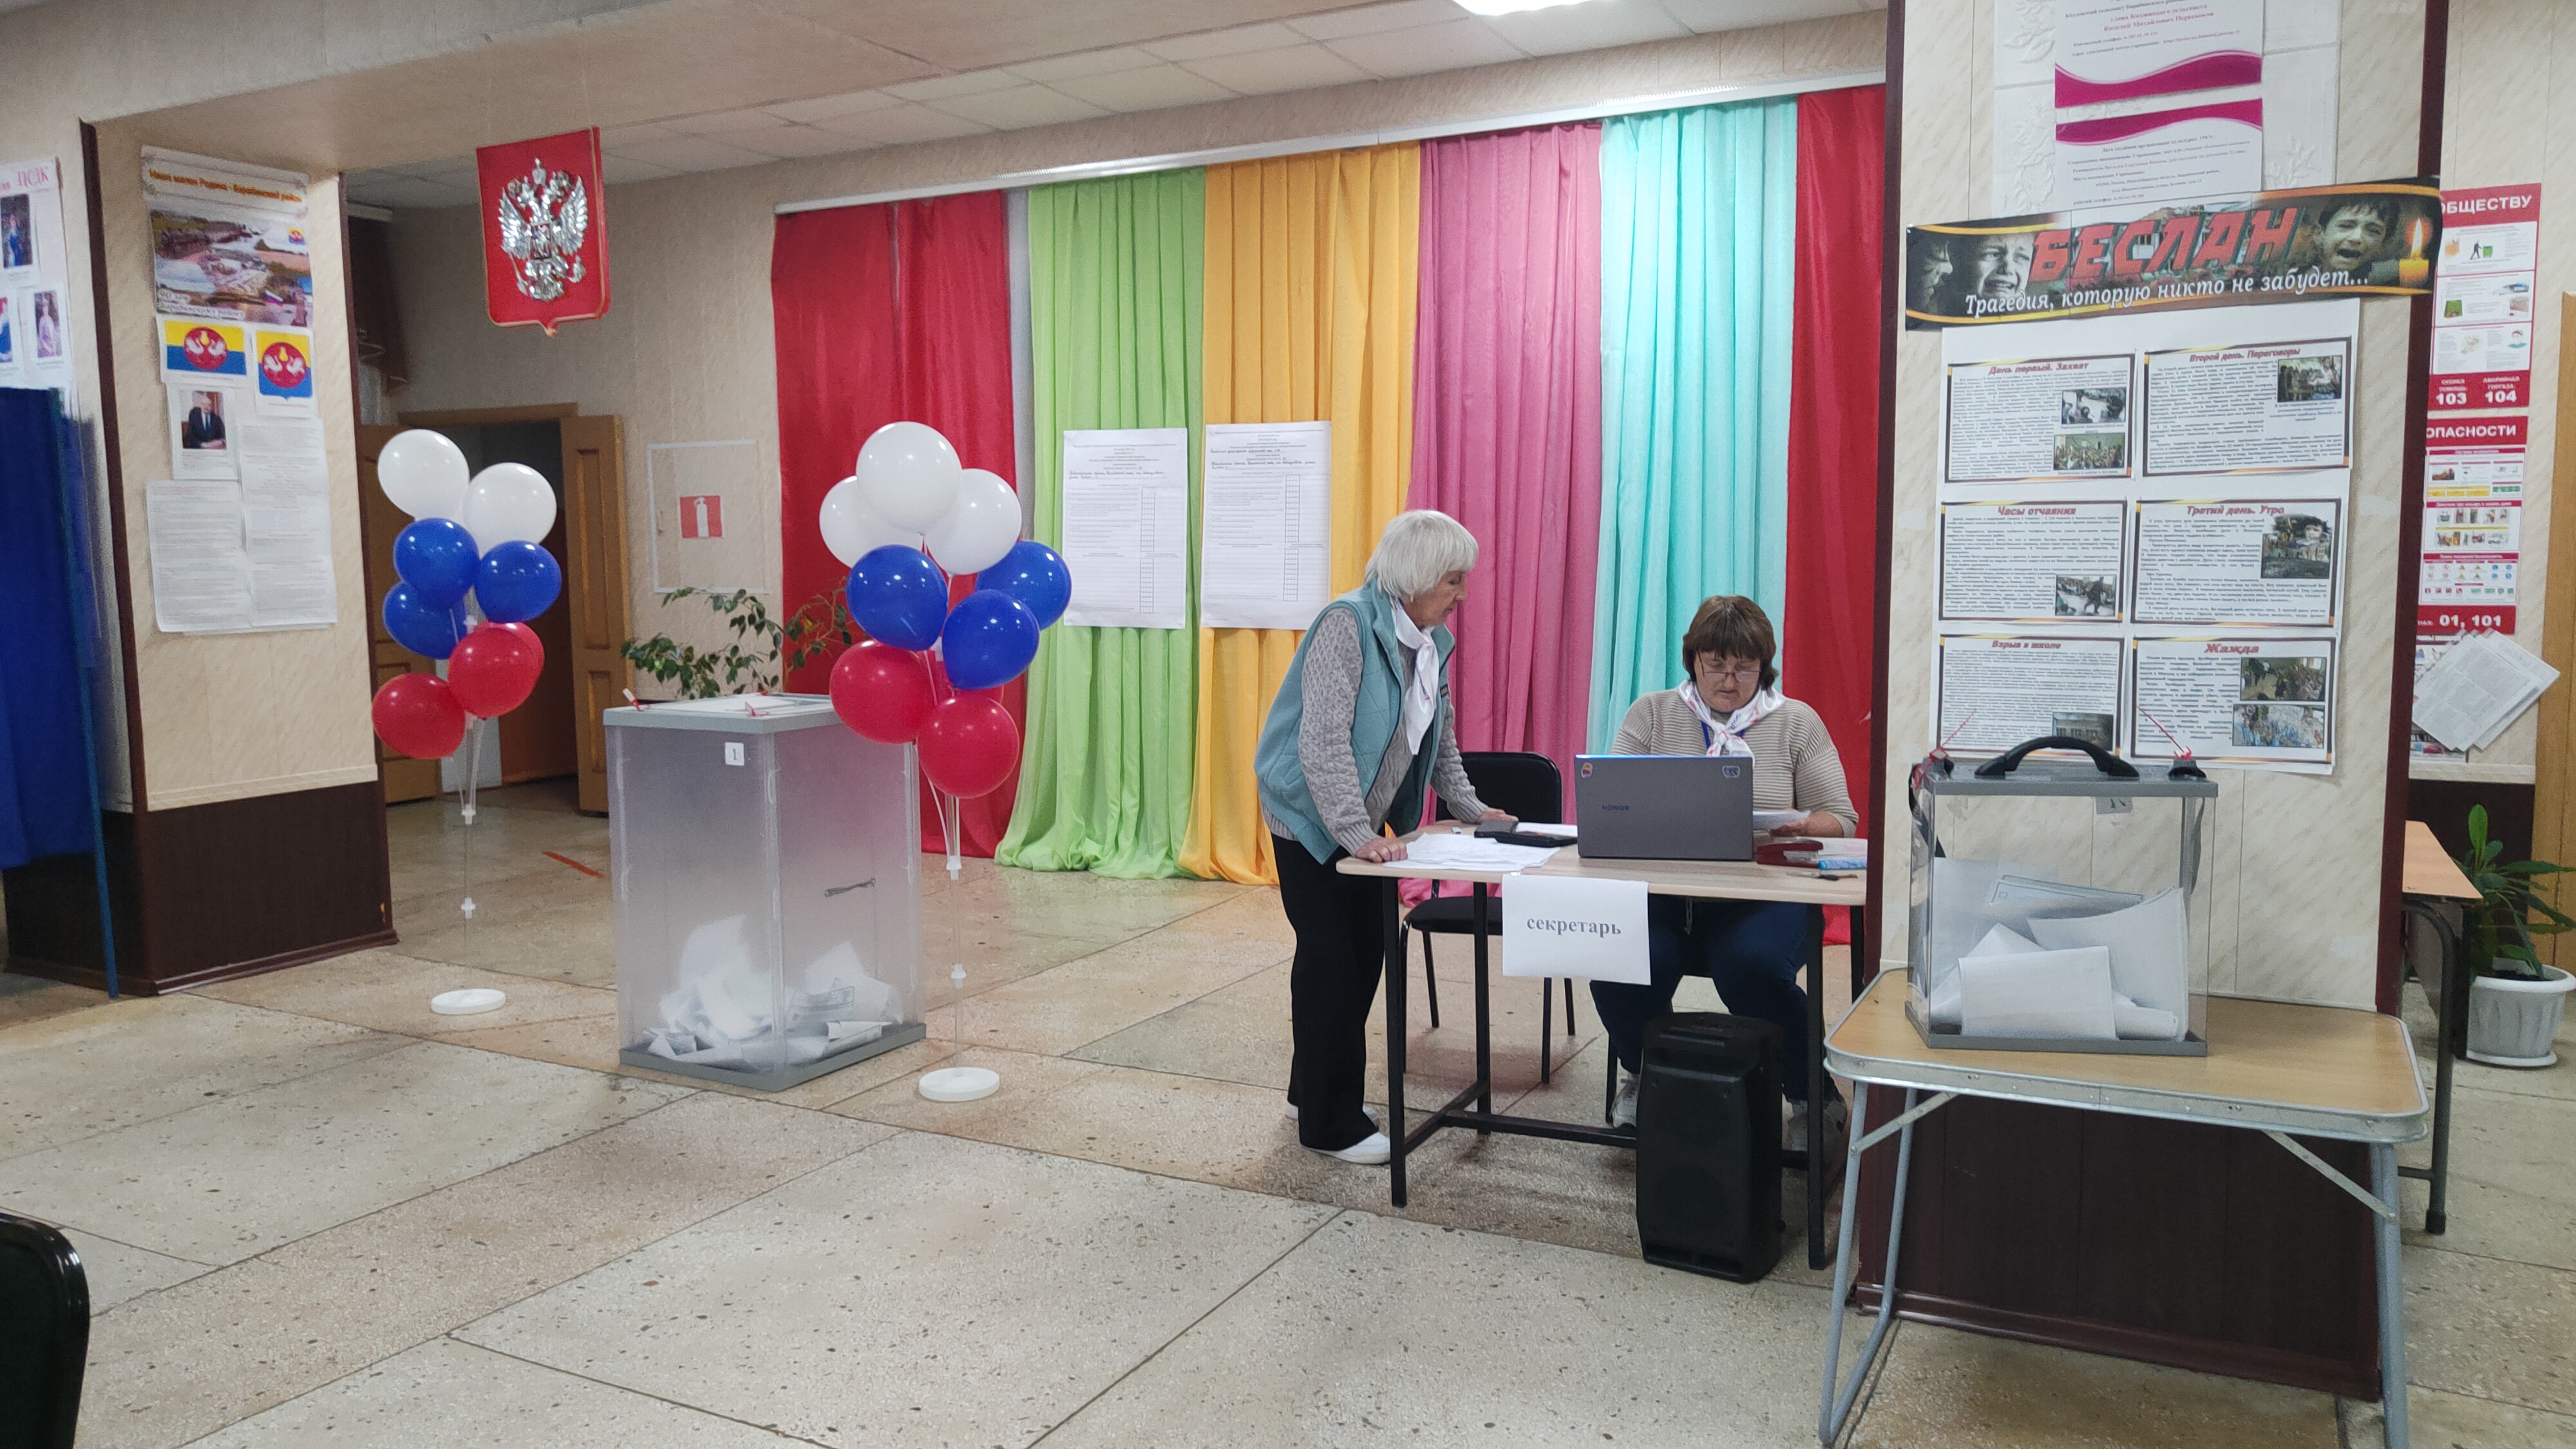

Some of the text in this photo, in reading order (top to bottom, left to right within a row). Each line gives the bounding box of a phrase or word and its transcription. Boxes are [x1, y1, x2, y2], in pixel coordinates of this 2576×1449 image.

[2028, 206, 2301, 282] БЕСЛАН
[1965, 265, 2369, 318] Трагедия, которую никто не забудет...
[2189, 348, 2301, 363] Второй день. Переговоры
[1988, 363, 2089, 376] День первый. Захват
[2436, 392, 2467, 405] 103
[2485, 390, 2517, 403] 104
[1998, 506, 2077, 516] Часы отчаяния
[2187, 504, 2285, 517] Третий день. Утро
[2439, 614, 2465, 628] 01,
[2472, 614, 2501, 627] 101
[1992, 640, 2021, 649] Взрыв
[2203, 643, 2260, 654] Жажда
[732, 748, 737, 761] 1
[1526, 916, 1622, 938] секретарь
